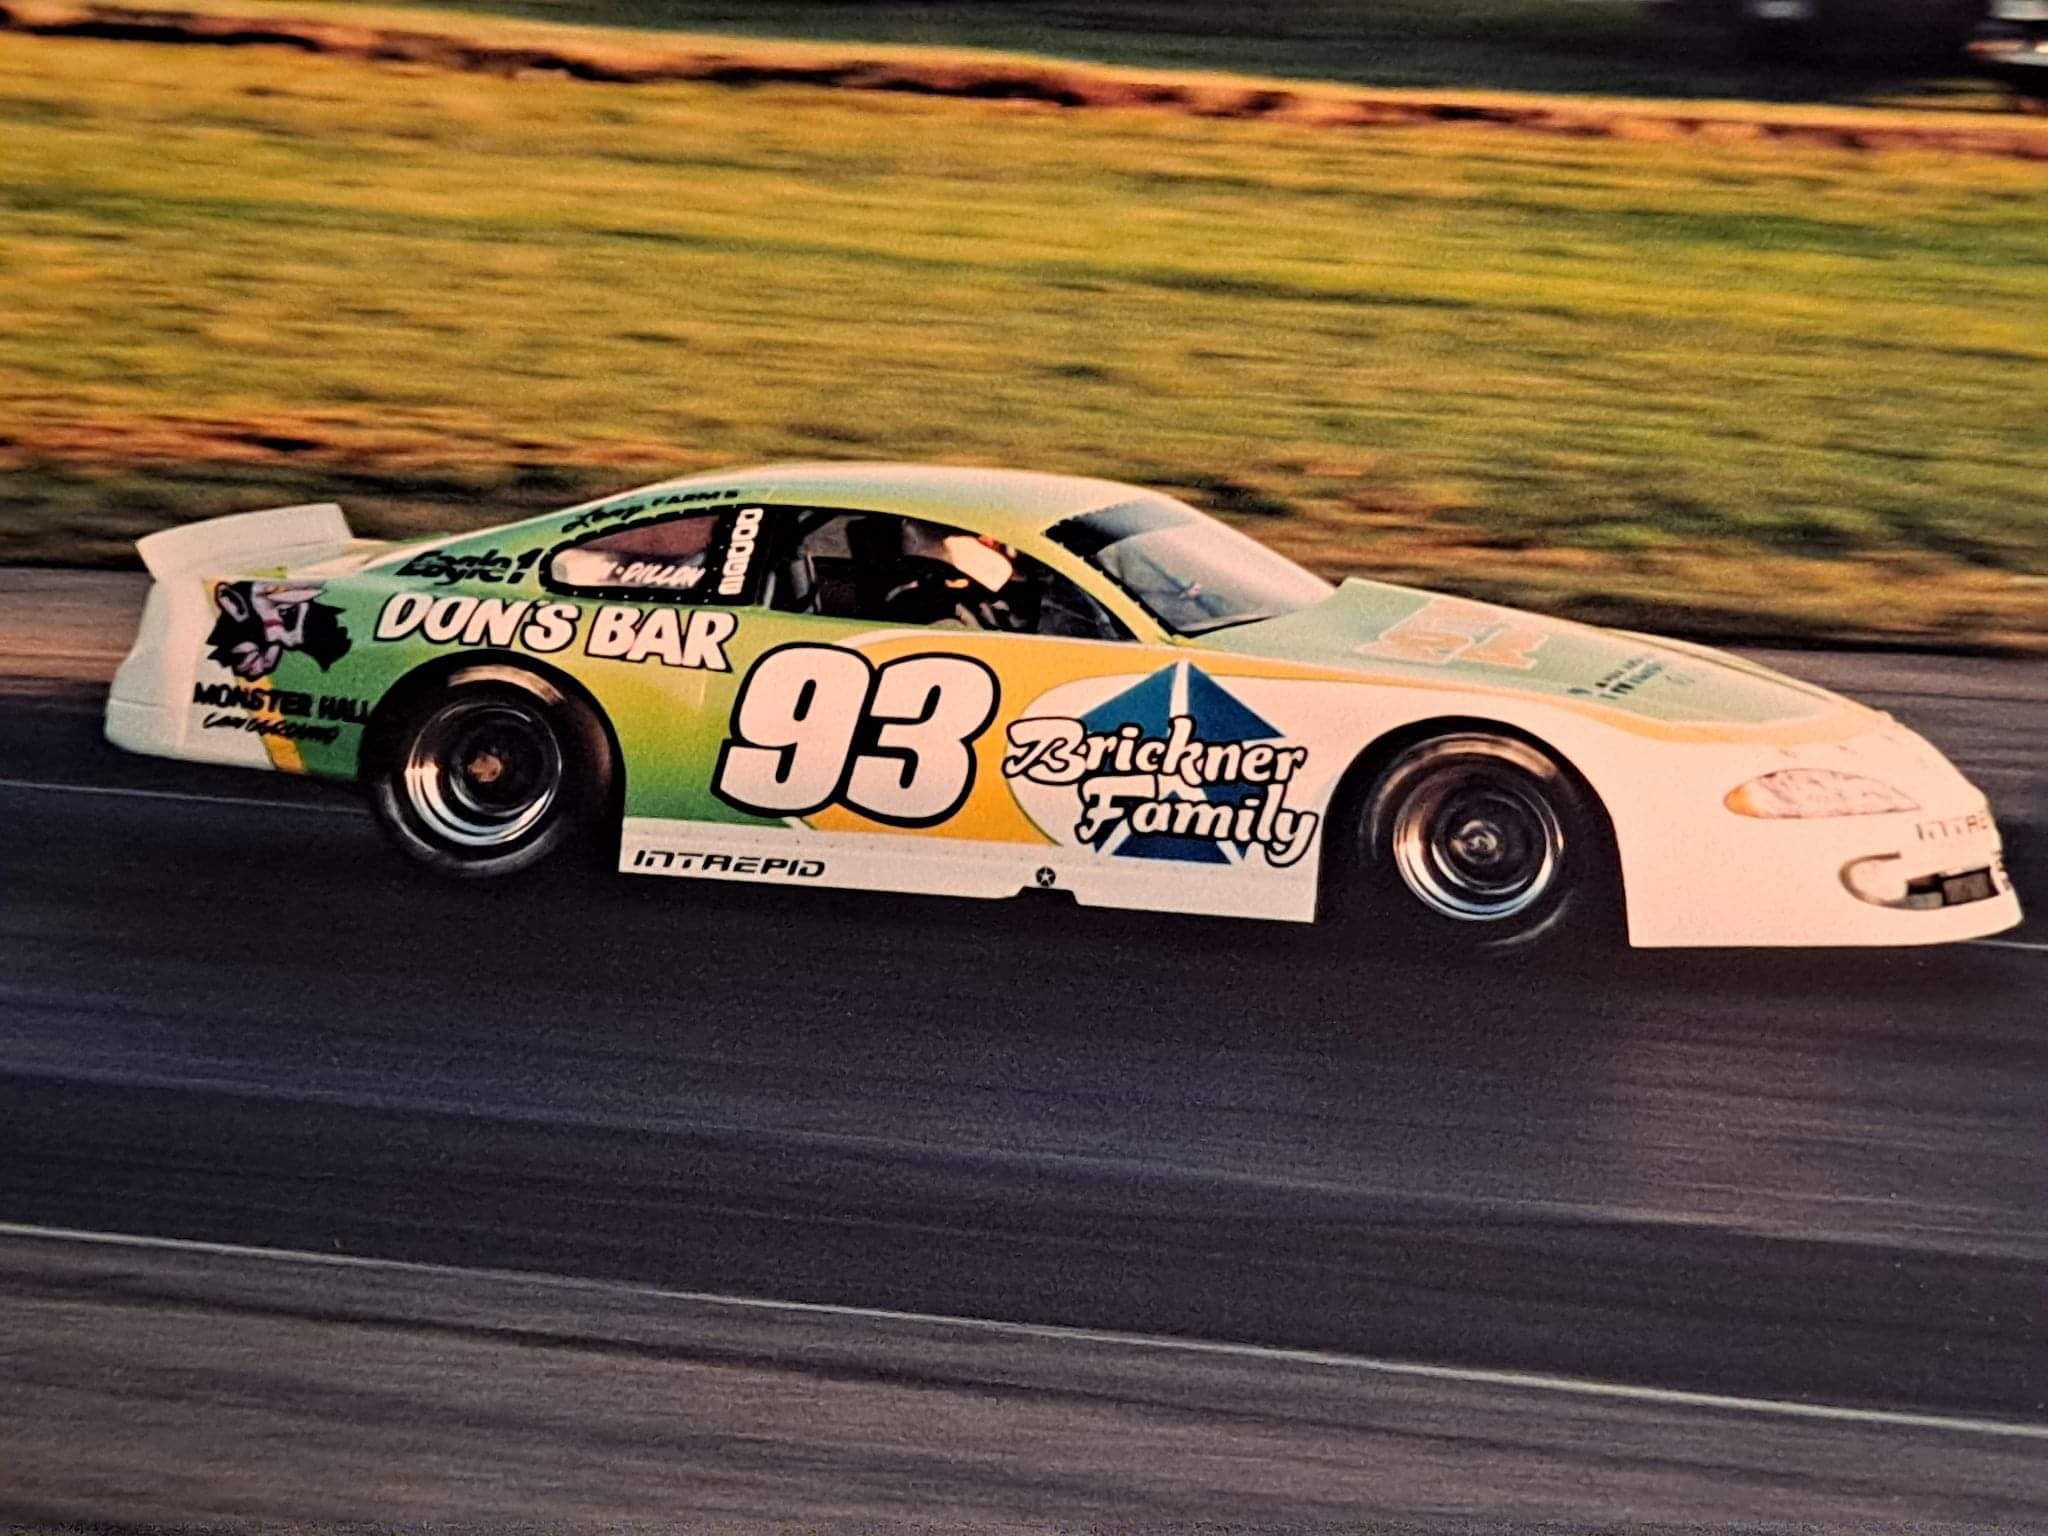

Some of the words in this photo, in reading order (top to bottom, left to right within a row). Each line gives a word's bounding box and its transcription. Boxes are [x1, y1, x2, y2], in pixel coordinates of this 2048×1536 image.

[718, 507, 764, 595] DODGE
[374, 593, 581, 652] DON'S
[585, 605, 738, 673] BAR
[193, 682, 312, 717] MONSTER
[711, 642, 1001, 828] 93
[1001, 715, 1308, 787] Brickner
[1074, 774, 1319, 867] Family
[634, 850, 826, 878] INTREPID
